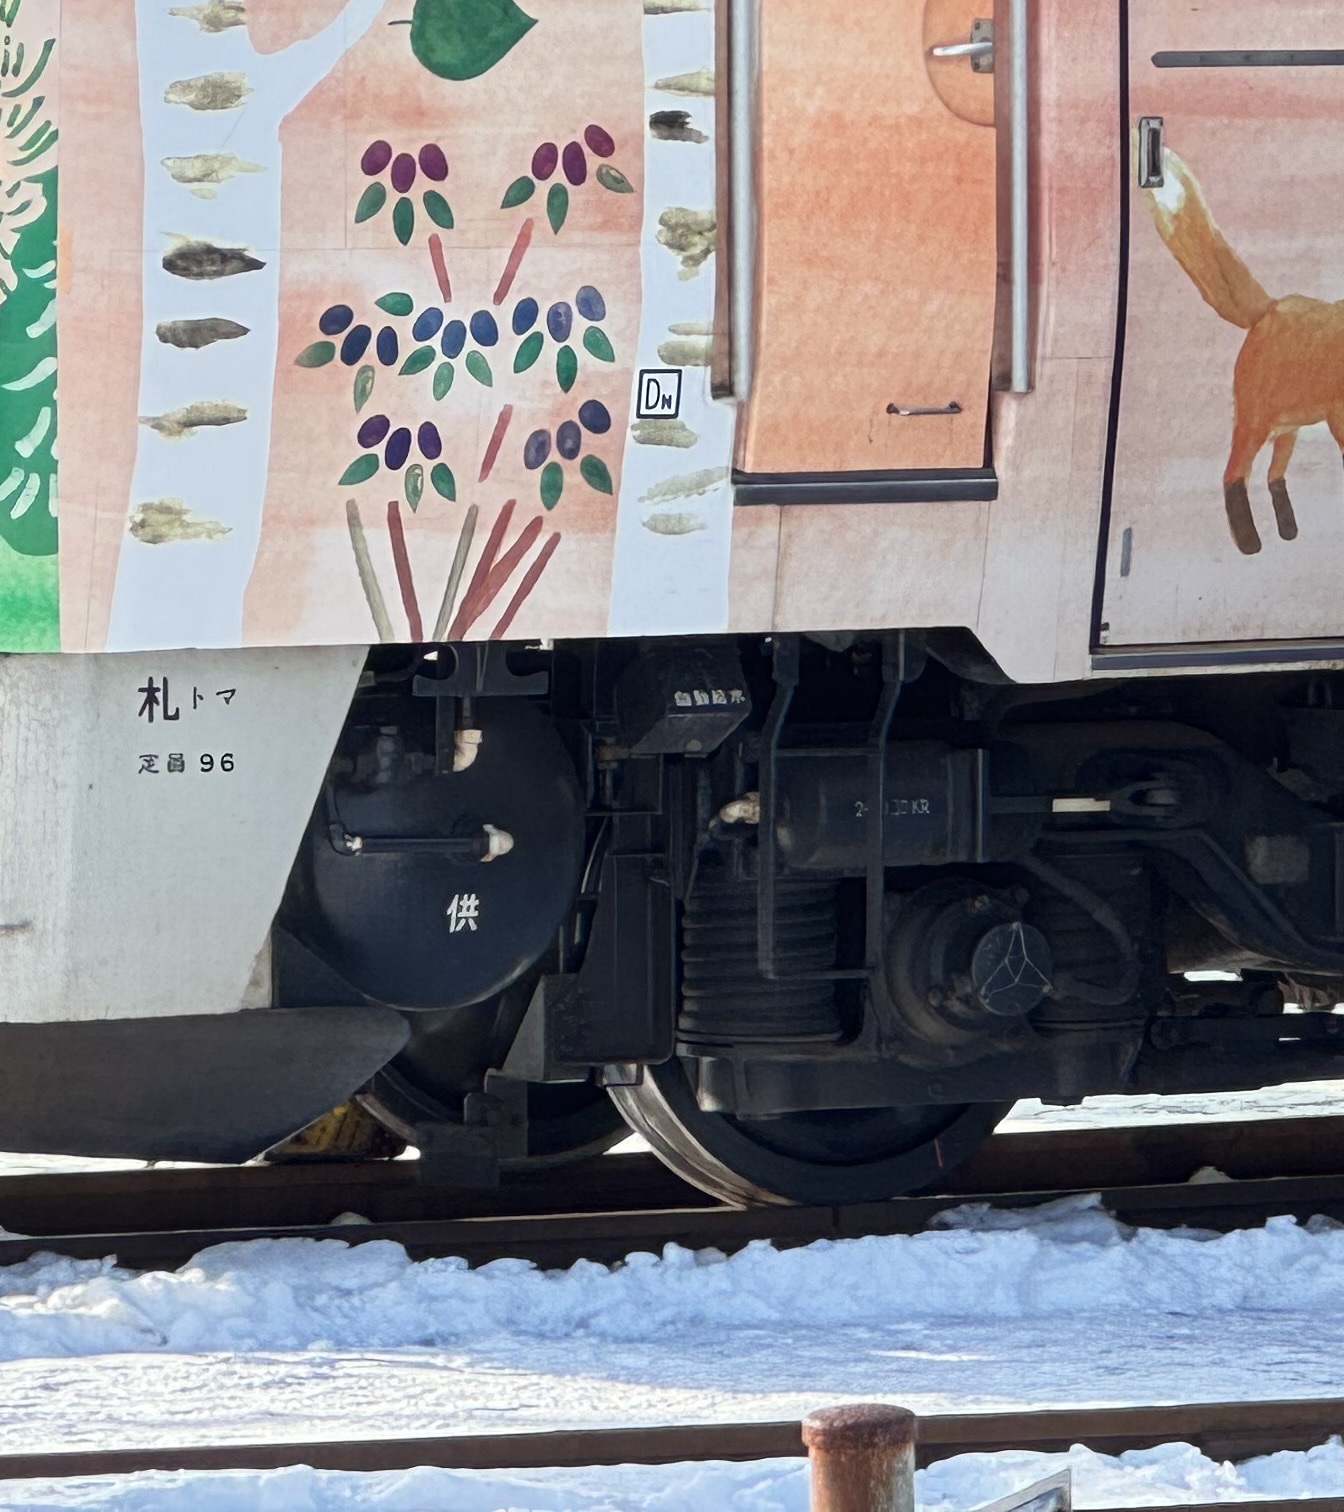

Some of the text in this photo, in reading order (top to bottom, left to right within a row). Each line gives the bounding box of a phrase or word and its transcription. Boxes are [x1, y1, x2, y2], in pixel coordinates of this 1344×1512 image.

[137, 676, 181, 724] 札
[199, 752, 236, 774] 96
[446, 893, 481, 934] 供
